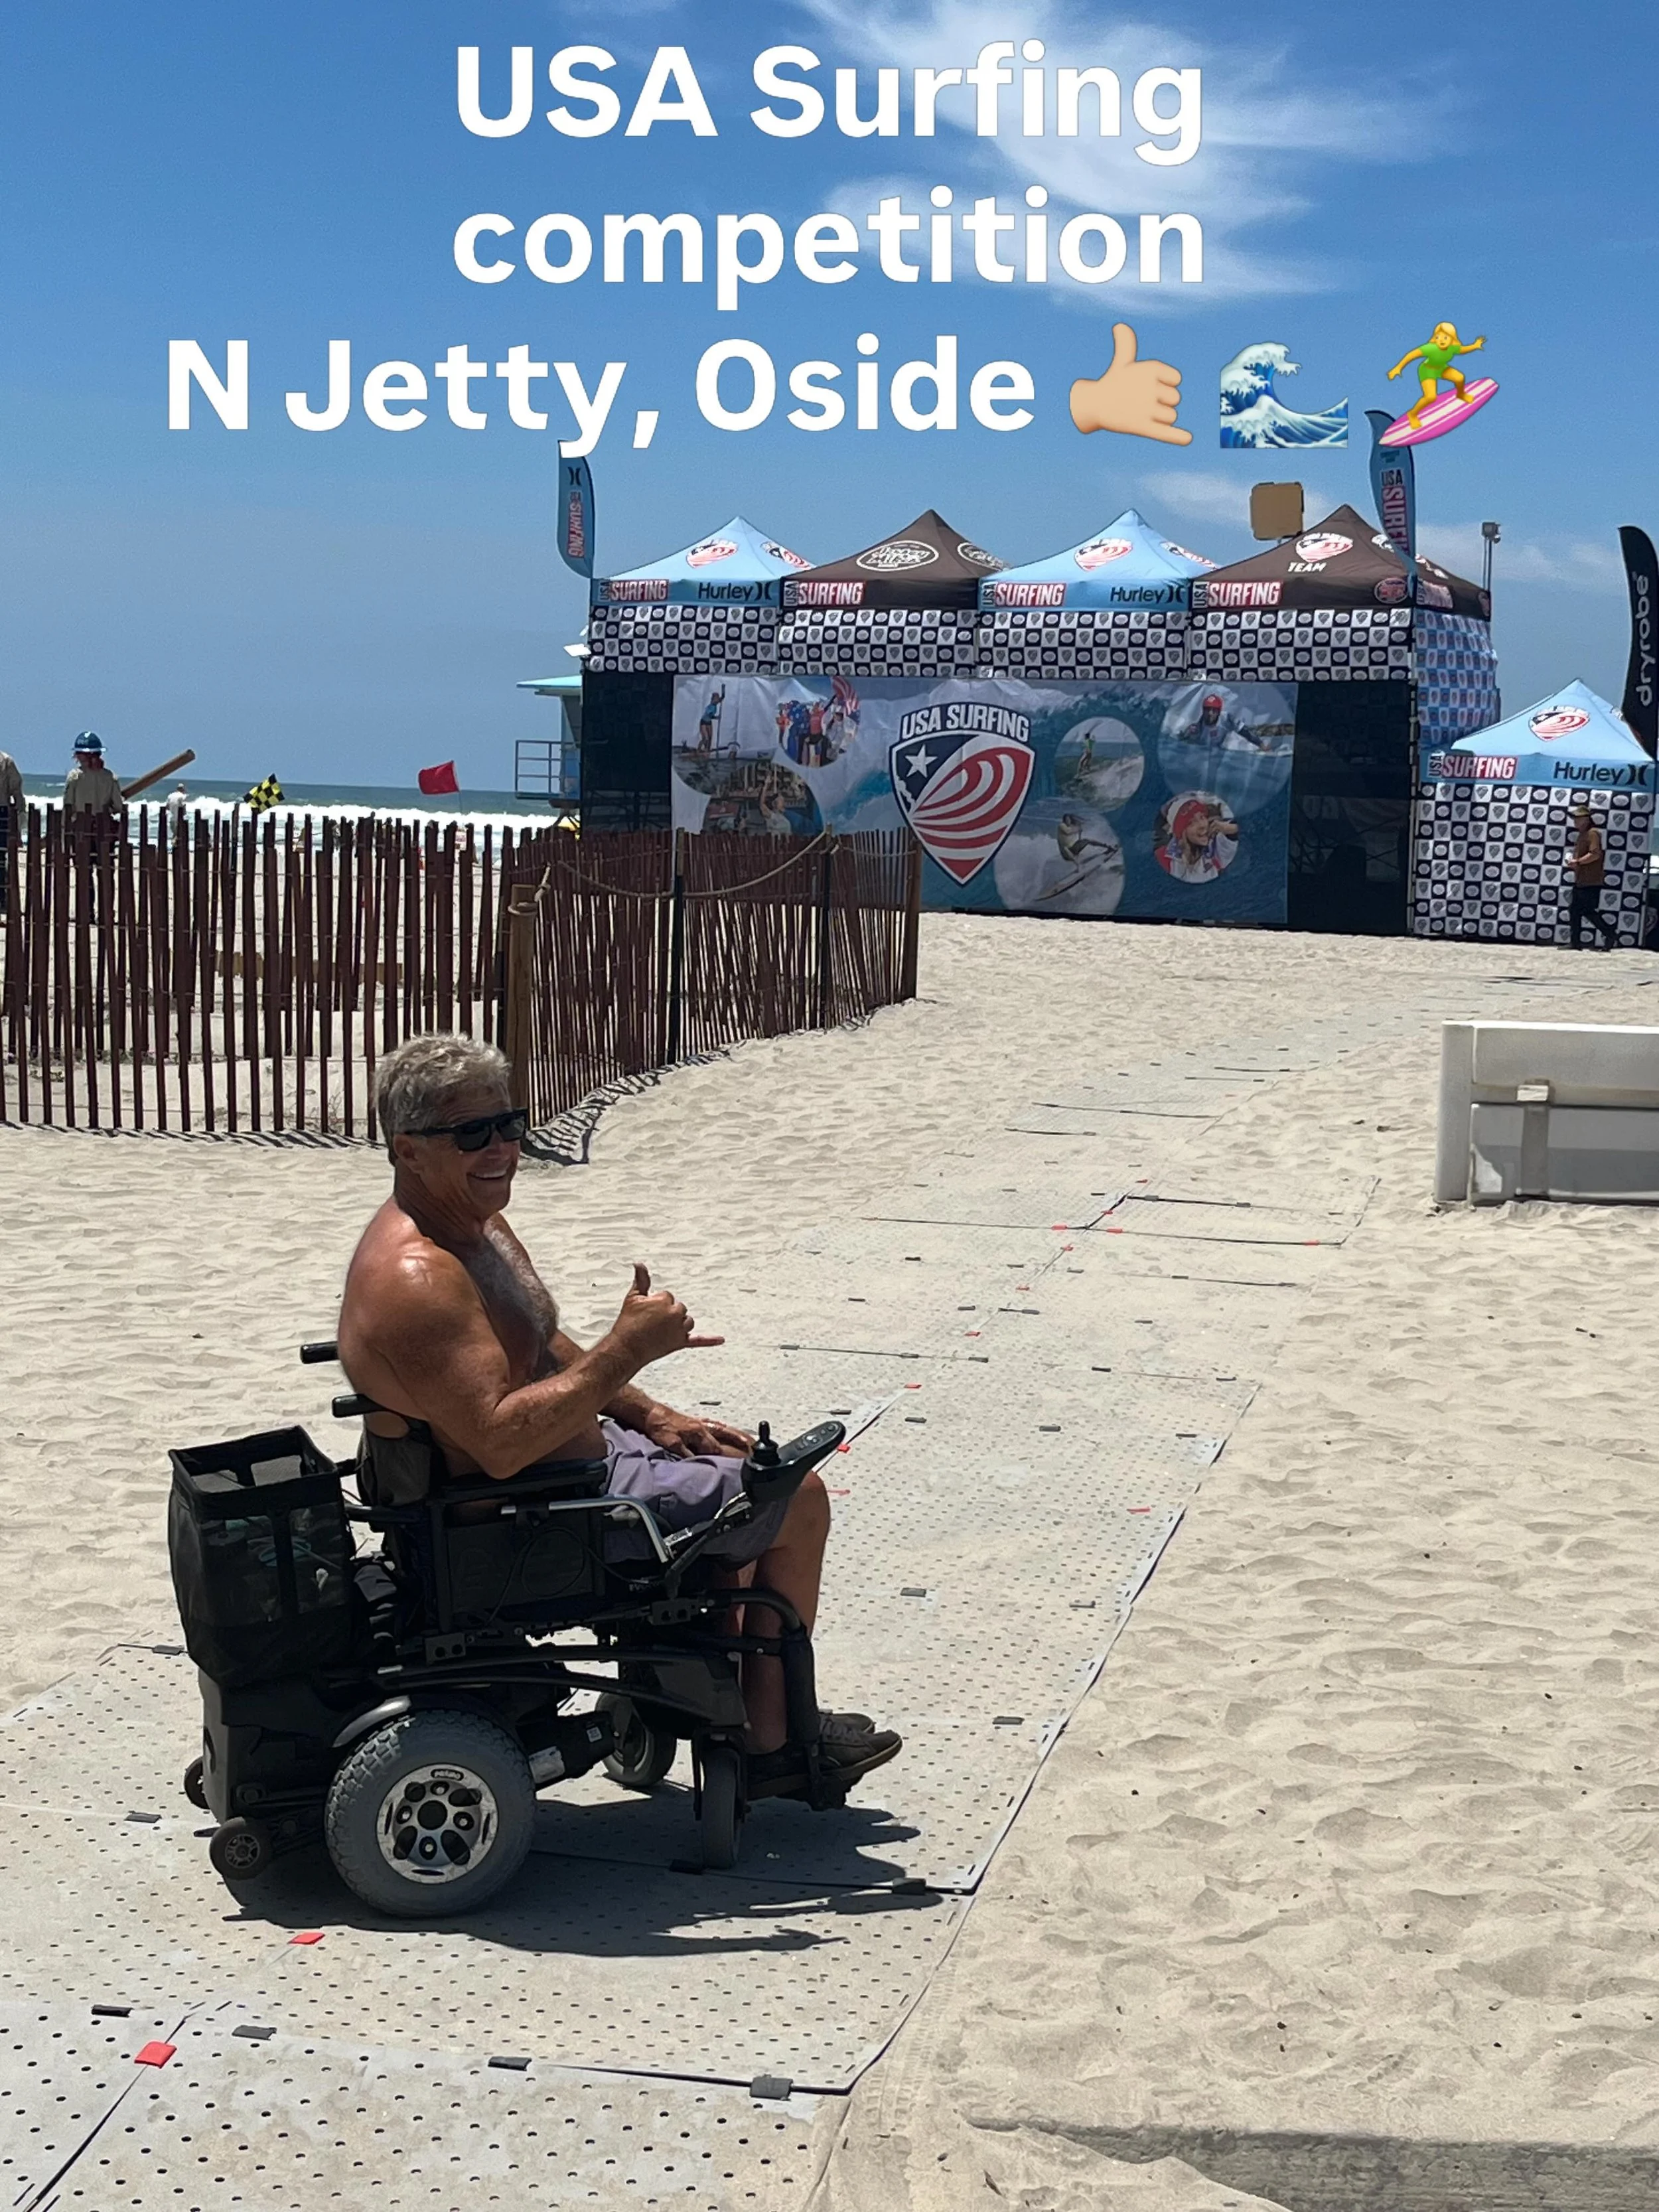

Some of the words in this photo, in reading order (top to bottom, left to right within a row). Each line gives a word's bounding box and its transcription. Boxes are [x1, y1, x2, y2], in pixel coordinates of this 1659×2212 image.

[1381, 469, 1403, 486] USA
[1288, 562, 1327, 572] TEAM
[610, 580, 668, 601] SURFING
[698, 582, 753, 601] Hurley
[784, 581, 798, 607] USA
[798, 582, 863, 606] SURFING
[982, 581, 995, 606] USA
[996, 583, 1064, 606] SURFING
[1110, 586, 1165, 604] Hurley
[1194, 582, 1208, 608] USA
[1208, 581, 1281, 607] SURFING
[1636, 575, 1656, 707] dryrobe
[901, 707, 942, 740] USA
[946, 703, 1029, 743] SURFING
[1442, 755, 1517, 779] SURFING
[1553, 761, 1624, 785] Hurley
